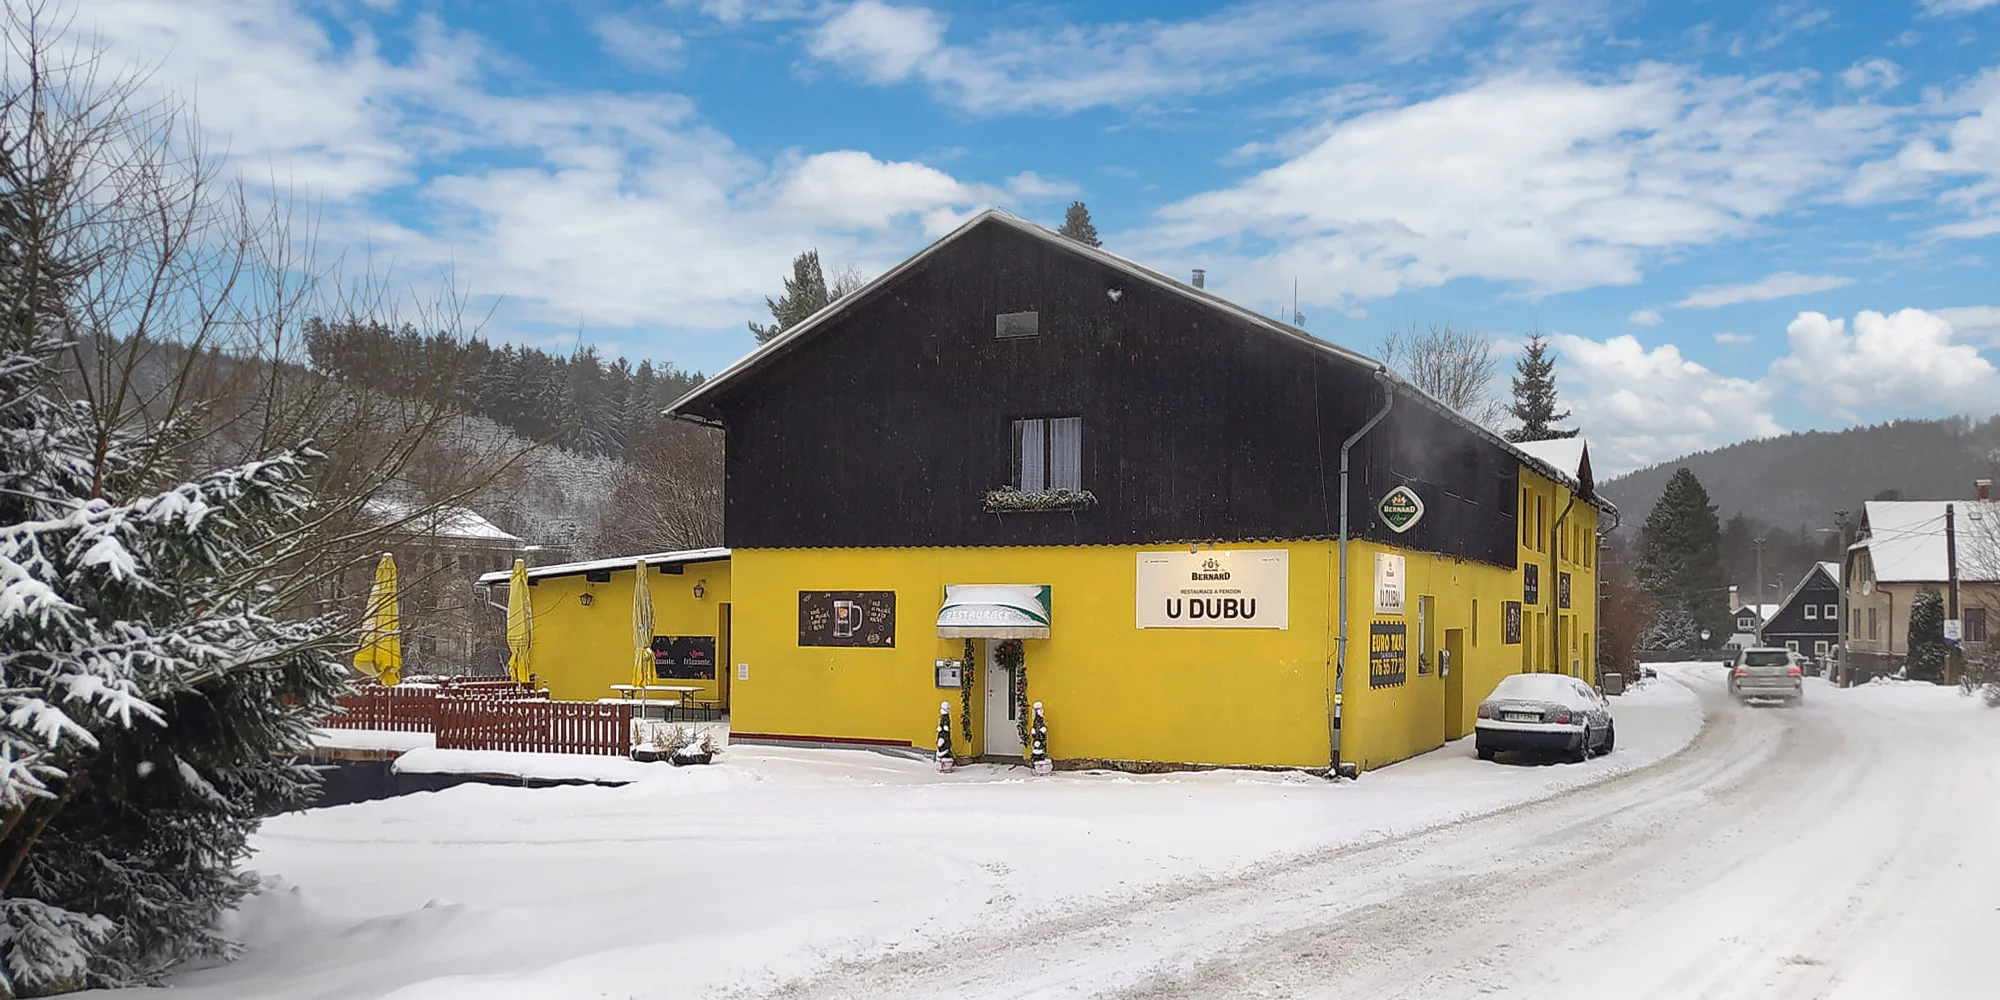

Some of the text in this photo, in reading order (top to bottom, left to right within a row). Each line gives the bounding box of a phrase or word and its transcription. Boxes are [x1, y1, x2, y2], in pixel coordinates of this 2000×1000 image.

[1383, 505, 1416, 513] BERNARD
[1191, 572, 1231, 581] BERNARD
[1166, 598, 1256, 619] U DUBU
[1372, 633, 1390, 652] EURO
